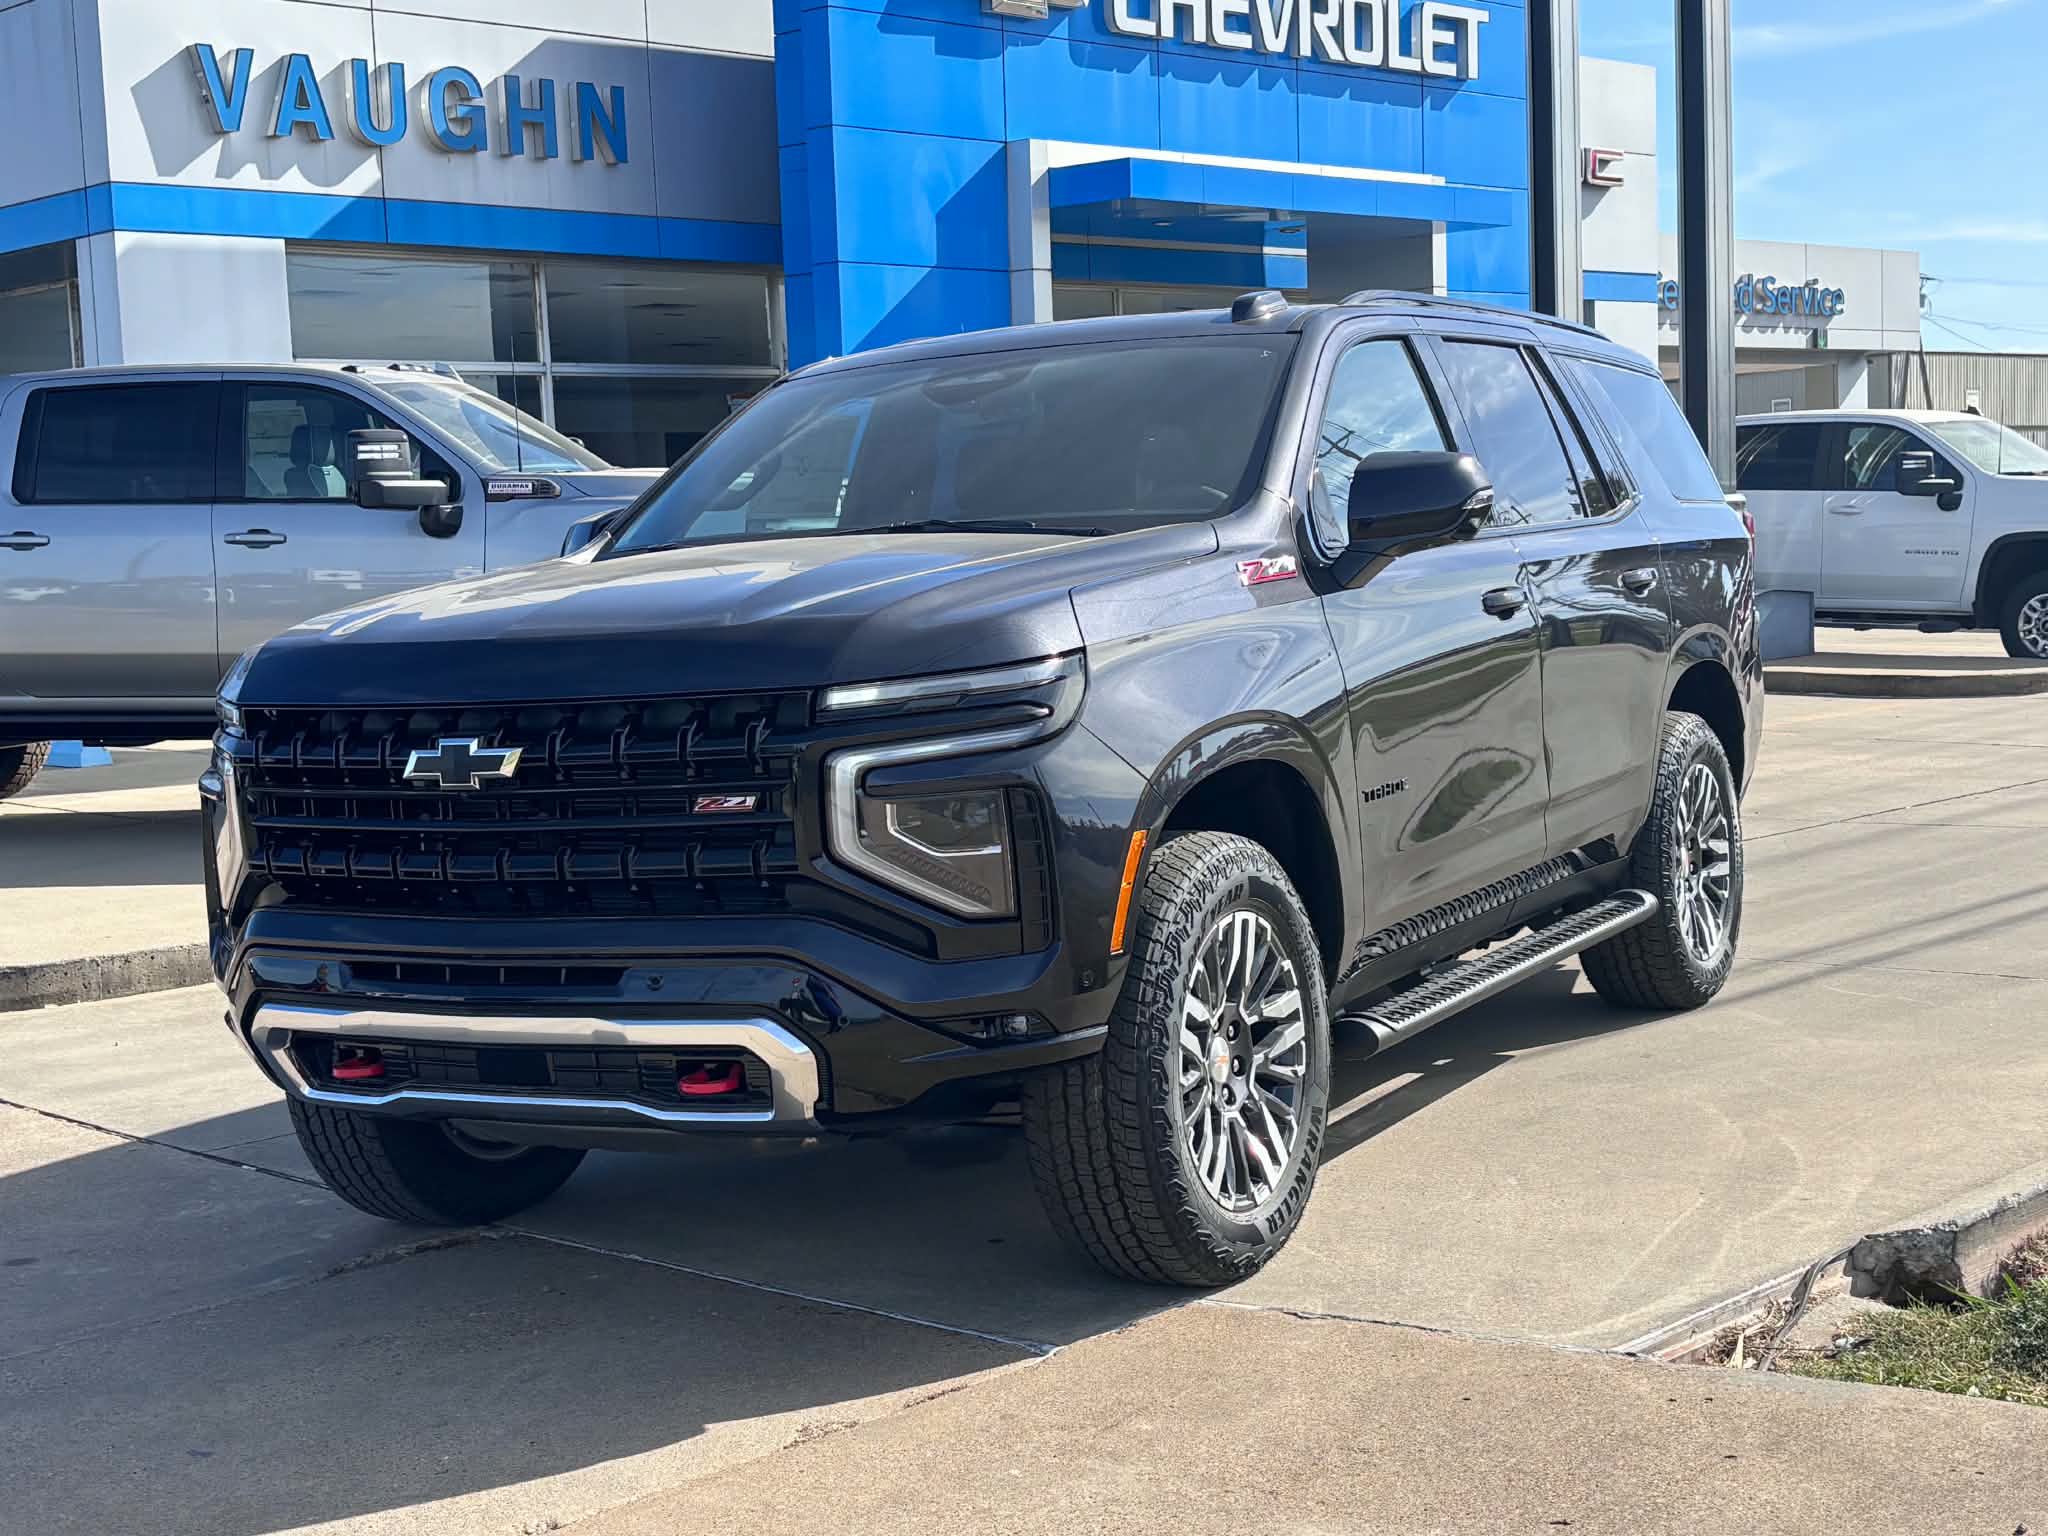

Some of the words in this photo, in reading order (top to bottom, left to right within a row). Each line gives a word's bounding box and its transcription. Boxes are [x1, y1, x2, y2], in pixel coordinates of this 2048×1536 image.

[1110, 0, 1489, 80] CHEVROLET
[193, 43, 628, 165] VAUGHN
[1761, 275, 1845, 316] Service
[692, 795, 757, 813] Z71
[1265, 1105, 1324, 1235] WRANGLER
